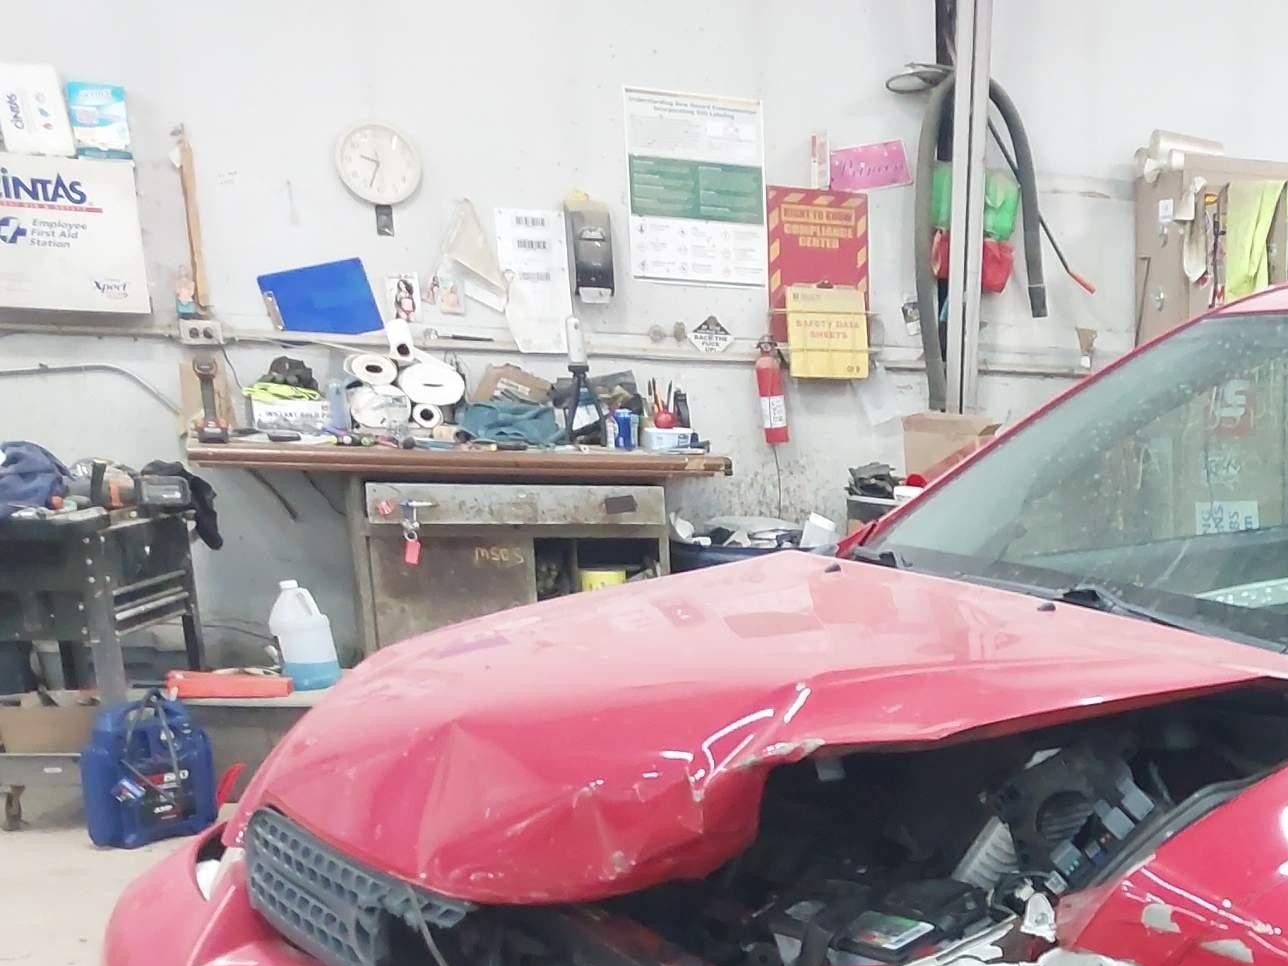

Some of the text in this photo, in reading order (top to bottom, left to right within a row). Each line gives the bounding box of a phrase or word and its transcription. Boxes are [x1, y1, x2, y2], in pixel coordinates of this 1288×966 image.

[32, 219, 87, 230] Employee
[31, 229, 79, 239] First Aid
[784, 223, 853, 238] COMPLIANCE
[30, 239, 70, 248] Station
[799, 236, 839, 249] CENTER
[796, 320, 860, 329] SAFETY DATA
